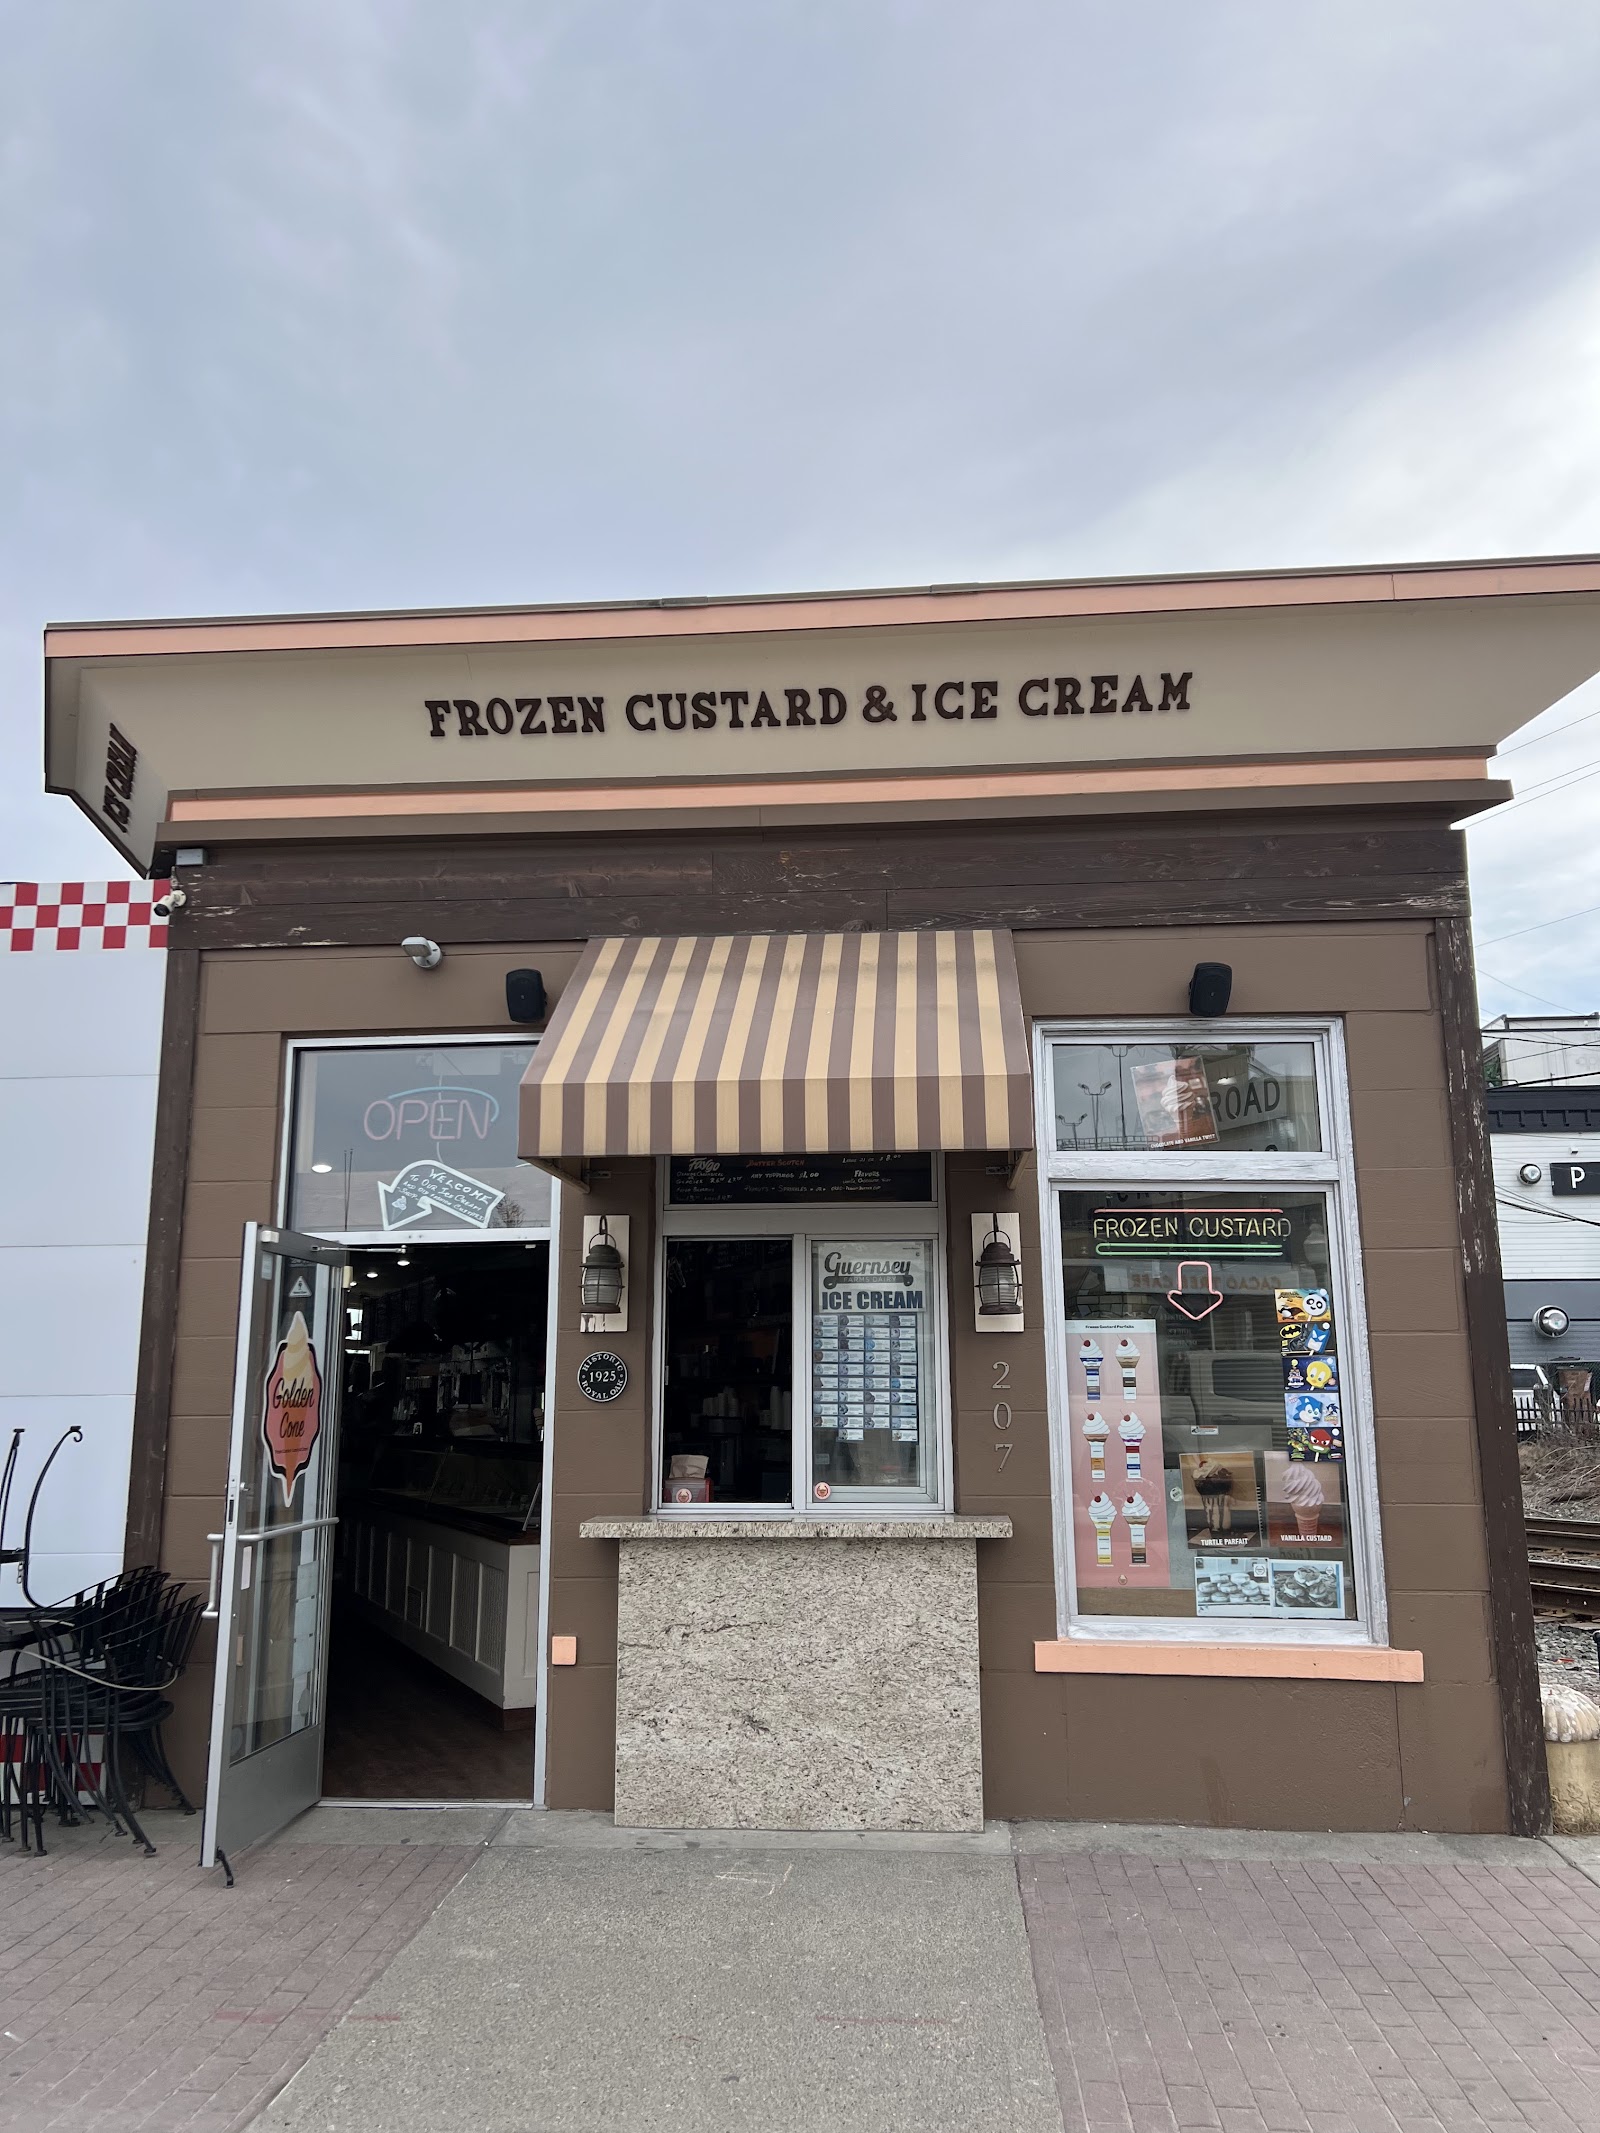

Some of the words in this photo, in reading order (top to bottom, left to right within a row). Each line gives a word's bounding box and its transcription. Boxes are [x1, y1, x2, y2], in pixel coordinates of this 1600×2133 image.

[425, 697, 605, 737] FROZEN
[625, 687, 847, 732] CUSTARD
[862, 685, 897, 723] &
[911, 680, 998, 722] ICE
[1018, 672, 1193, 717] CREAM
[363, 1100, 491, 1141] OPEN
[688, 1157, 721, 1173] Faygo
[429, 1168, 492, 1205] WELCOME
[1570, 1166, 1586, 1189] P
[454, 1194, 482, 1210] CREAM
[1093, 1217, 1179, 1239] FROZEN
[1189, 1216, 1292, 1238] CUSTARD
[824, 1251, 912, 1283] Guernsey
[872, 1275, 897, 1283] DAIRY
[821, 1291, 852, 1310] ICE
[857, 1290, 923, 1310] CREAM
[582, 1353, 624, 1372] HISTORIC
[589, 1371, 617, 1383] 1925
[273, 1377, 315, 1409] Golden
[581, 1380, 609, 1399] ROYAL
[609, 1379, 624, 1396] OAK
[279, 1411, 305, 1439] Cone
[1280, 1534, 1305, 1542] VANILLA
[1305, 1534, 1333, 1542] CUSTARD
